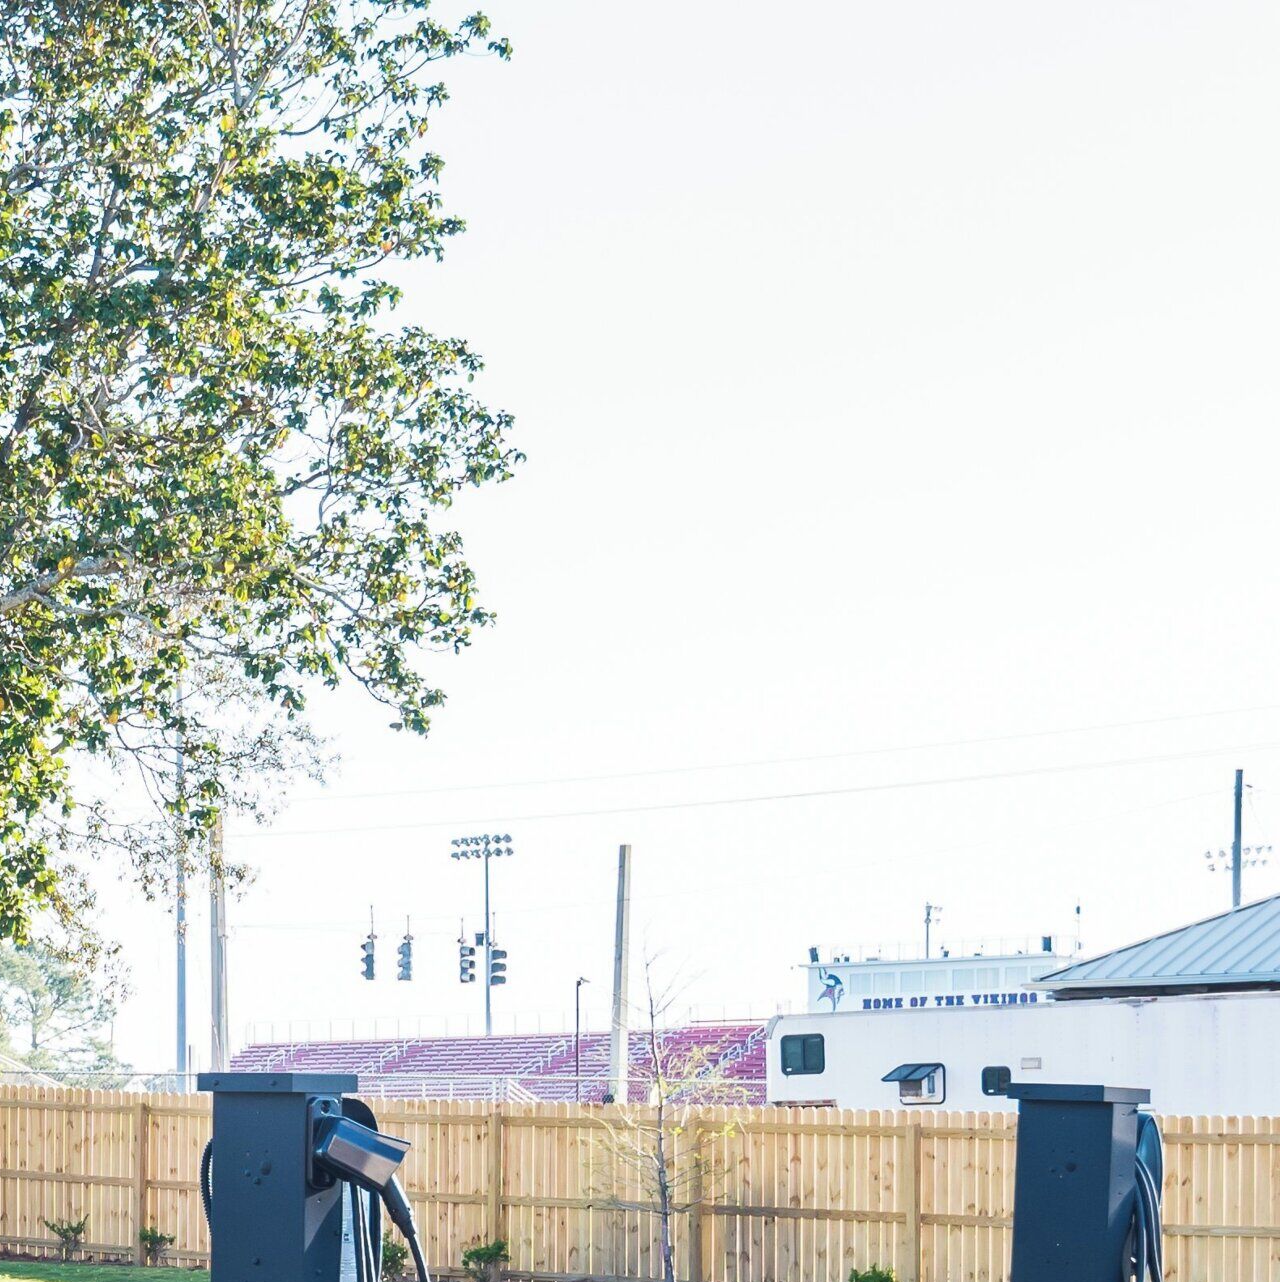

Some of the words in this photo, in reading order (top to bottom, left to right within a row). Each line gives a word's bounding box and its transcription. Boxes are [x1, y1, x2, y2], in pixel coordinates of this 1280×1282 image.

[862, 998, 903, 1010] HOME
[910, 996, 928, 1007] OF
[935, 995, 964, 1006] THE
